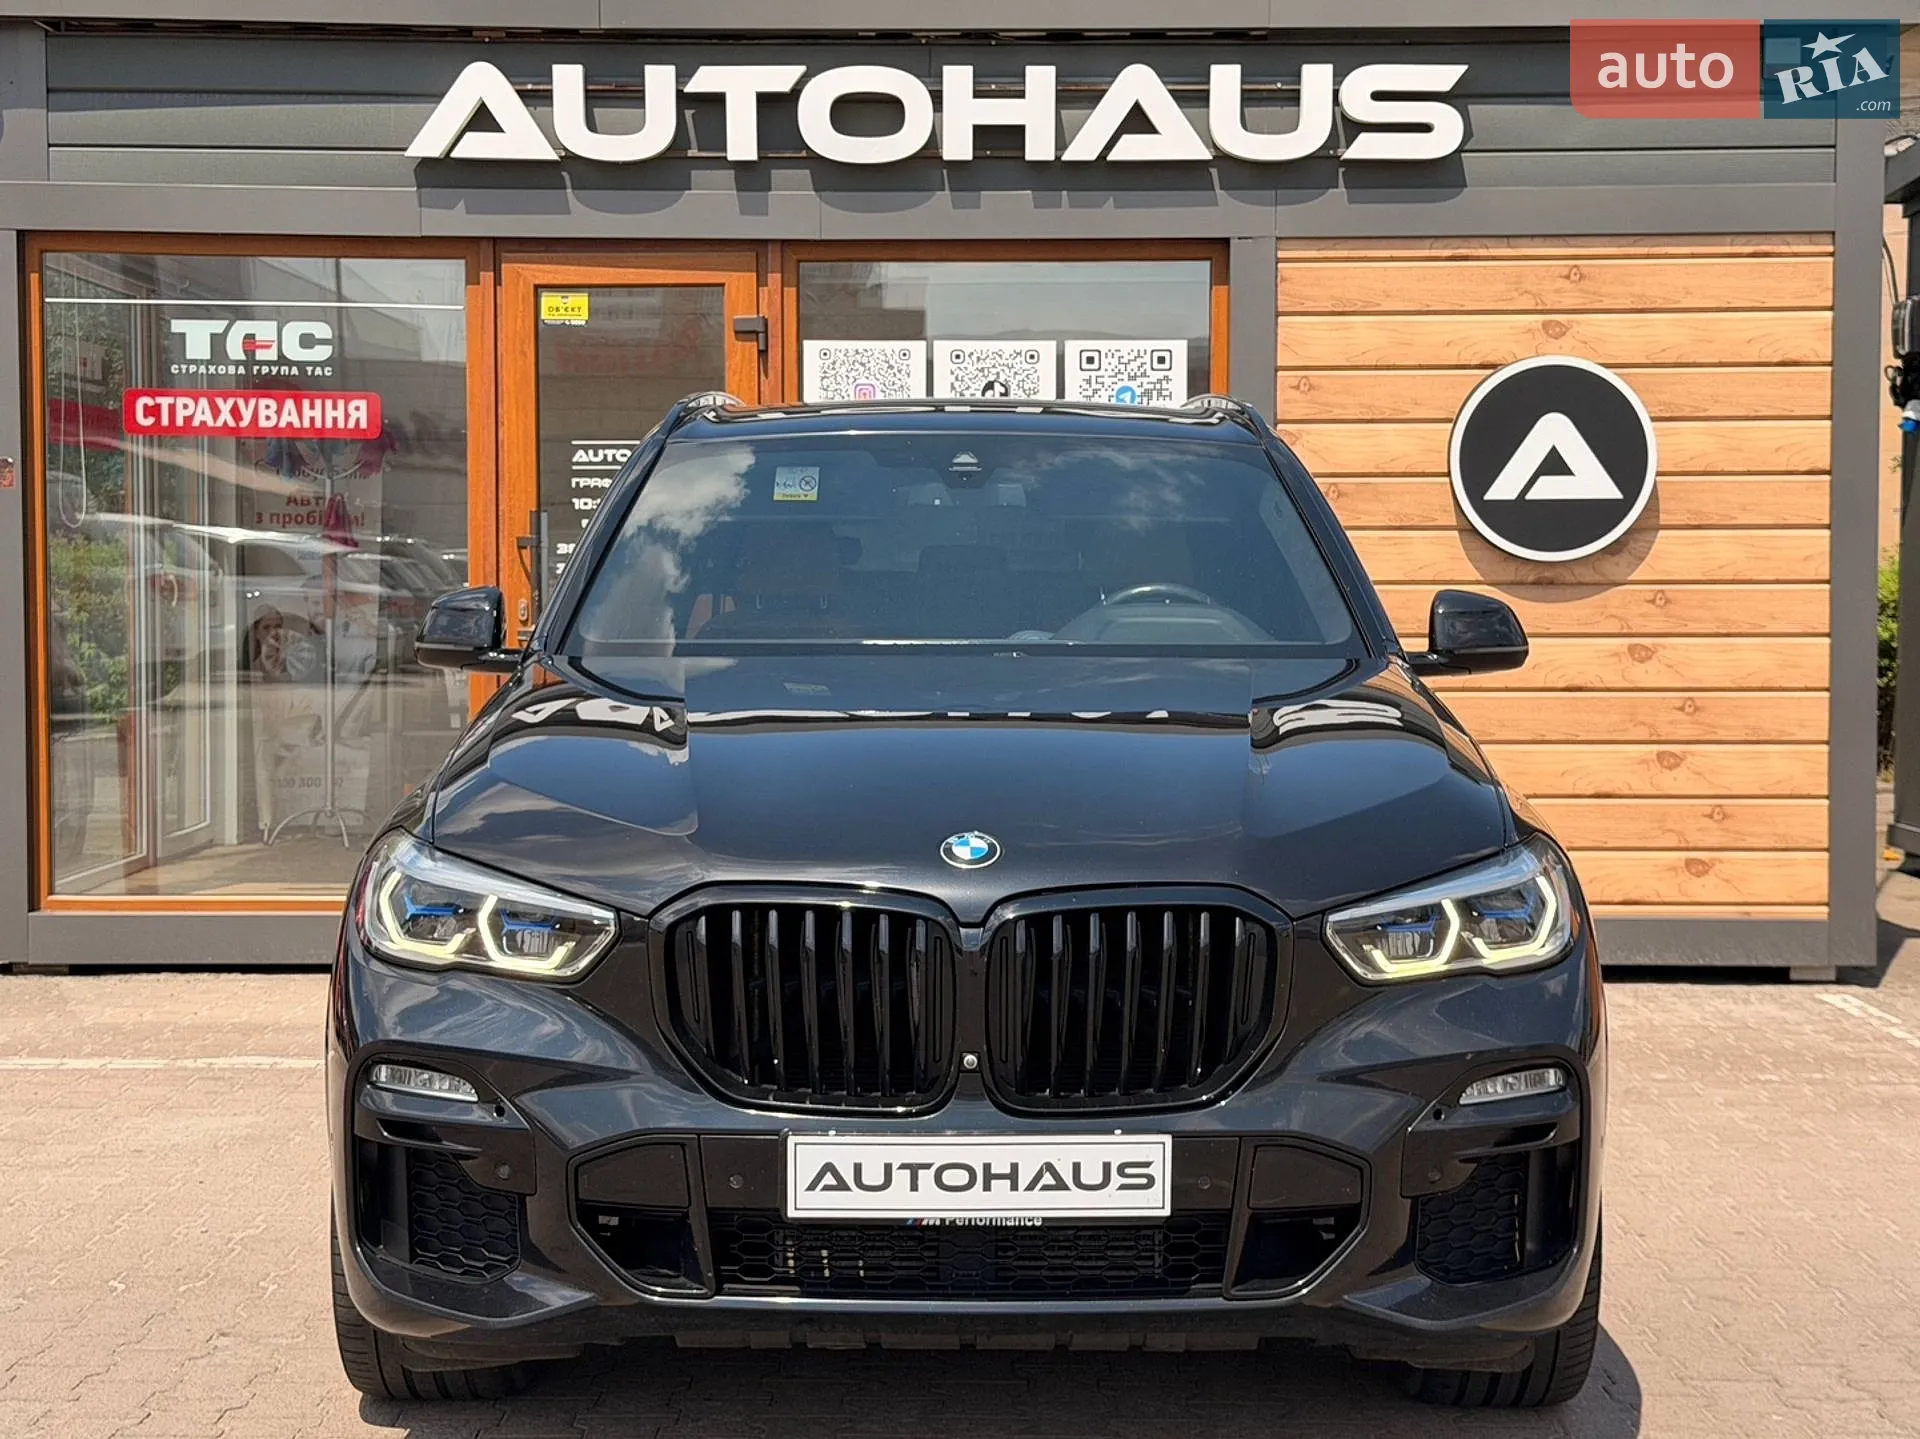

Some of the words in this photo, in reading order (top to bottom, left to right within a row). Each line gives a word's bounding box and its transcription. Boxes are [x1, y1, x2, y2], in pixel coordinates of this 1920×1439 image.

[403, 60, 1469, 163] AUTOHAUS
[170, 363, 246, 375] СТРАХОВА
[253, 364, 299, 376] ГРУПА
[305, 365, 333, 377] ТАС
[134, 395, 369, 430] СТРАХУВАННЯ
[804, 1160, 1156, 1193] AUTOHAUS
